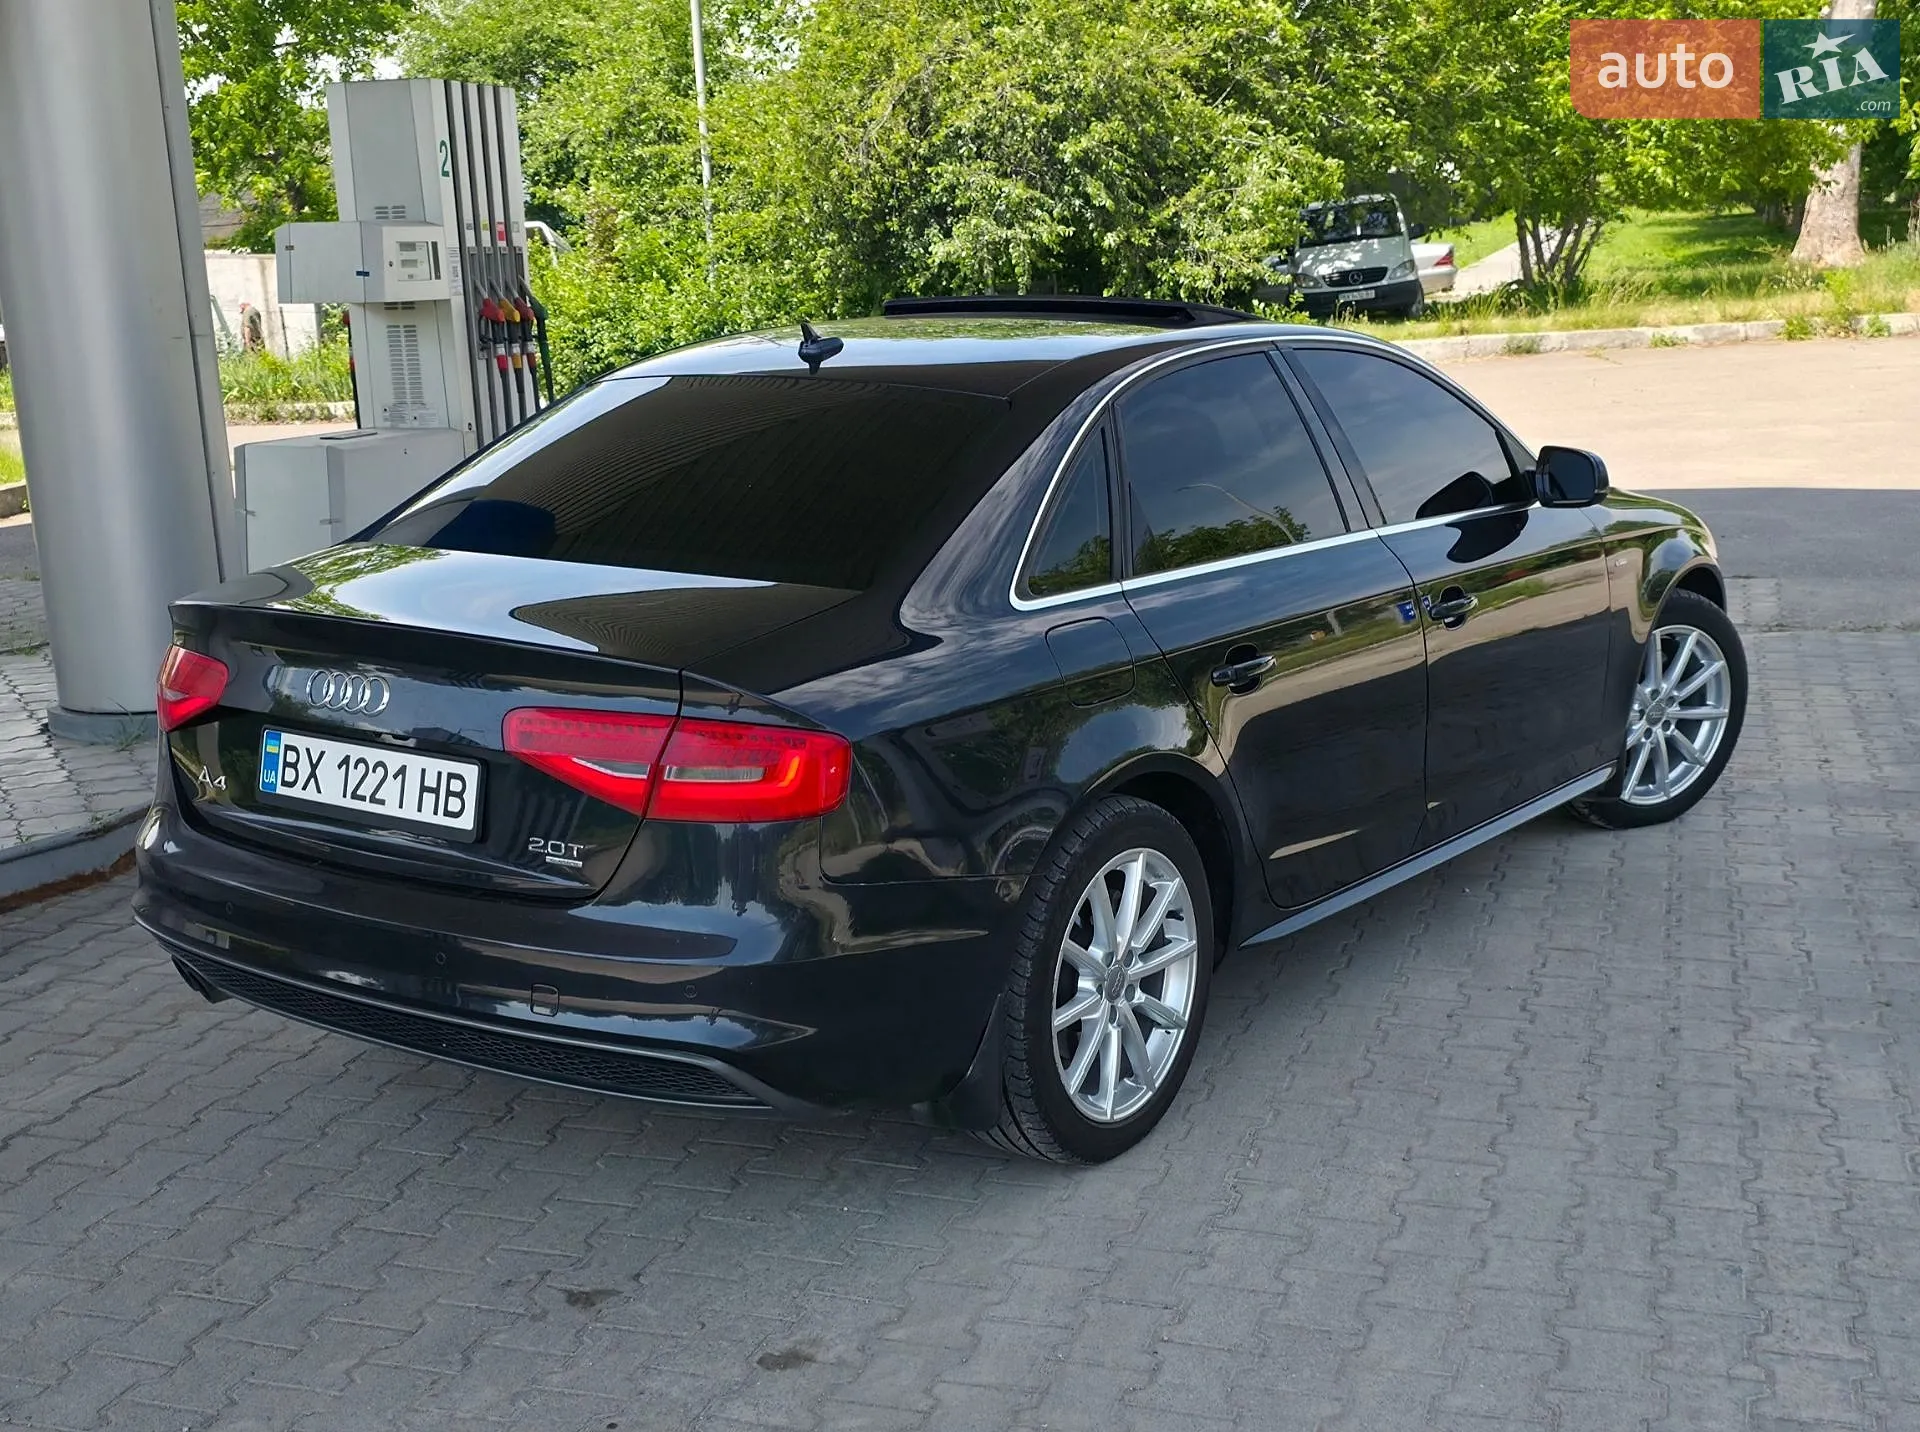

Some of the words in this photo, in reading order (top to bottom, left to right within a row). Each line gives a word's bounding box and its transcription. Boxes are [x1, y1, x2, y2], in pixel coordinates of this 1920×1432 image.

[439, 139, 450, 177] 2
[198, 765, 227, 791] A4
[263, 769, 276, 785] UA
[280, 744, 326, 794] BX
[337, 754, 407, 809] 1221
[417, 767, 467, 819] HB
